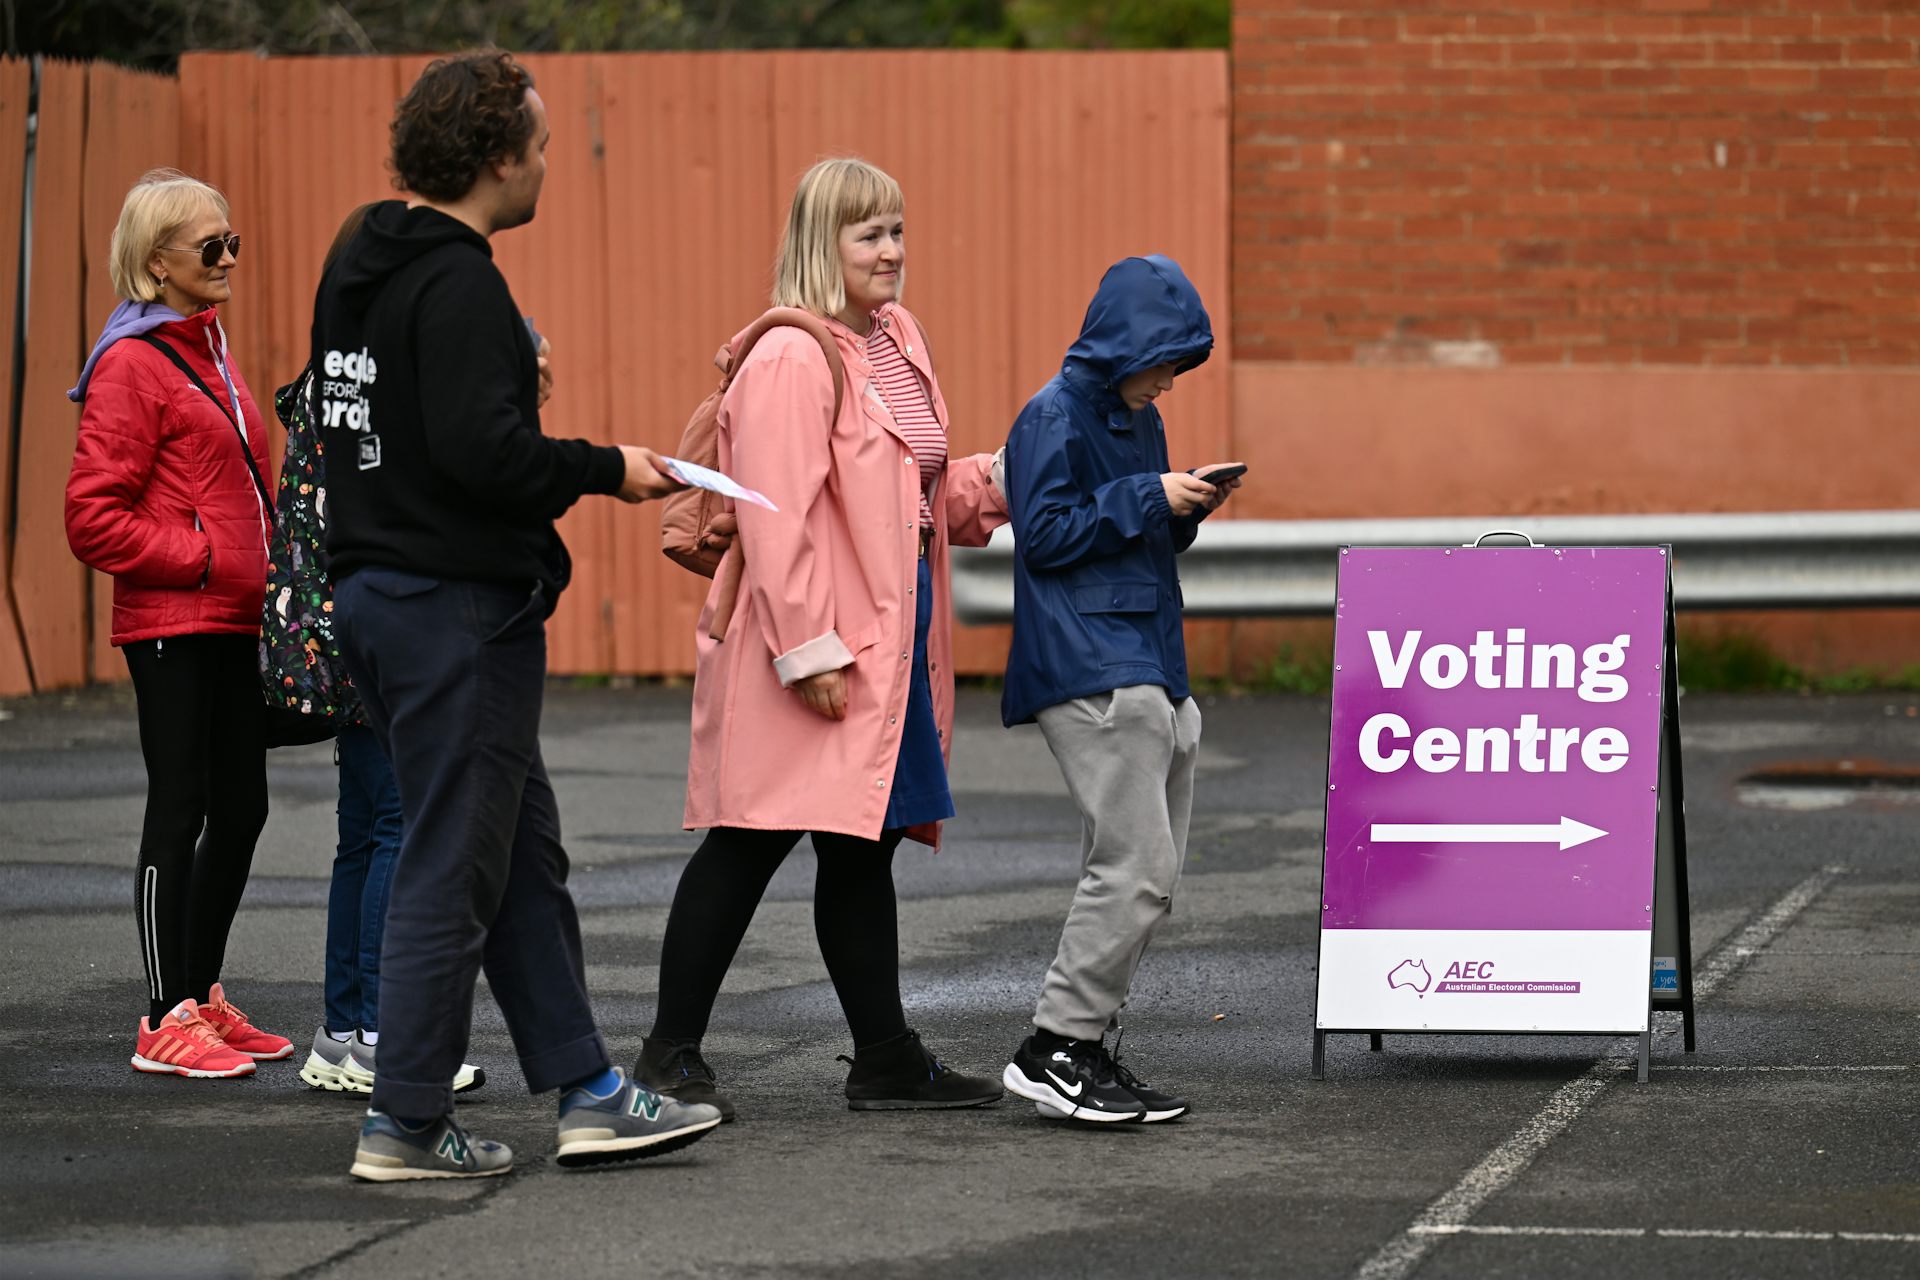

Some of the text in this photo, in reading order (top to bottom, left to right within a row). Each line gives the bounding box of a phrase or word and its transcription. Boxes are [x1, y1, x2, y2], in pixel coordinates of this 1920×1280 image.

[1367, 628, 1631, 703] Voting
[1358, 712, 1630, 773] Centre
[1443, 961, 1495, 980] AEC
[1445, 983, 1577, 992] Australian Electoral Commission
[629, 1088, 665, 1122] N
